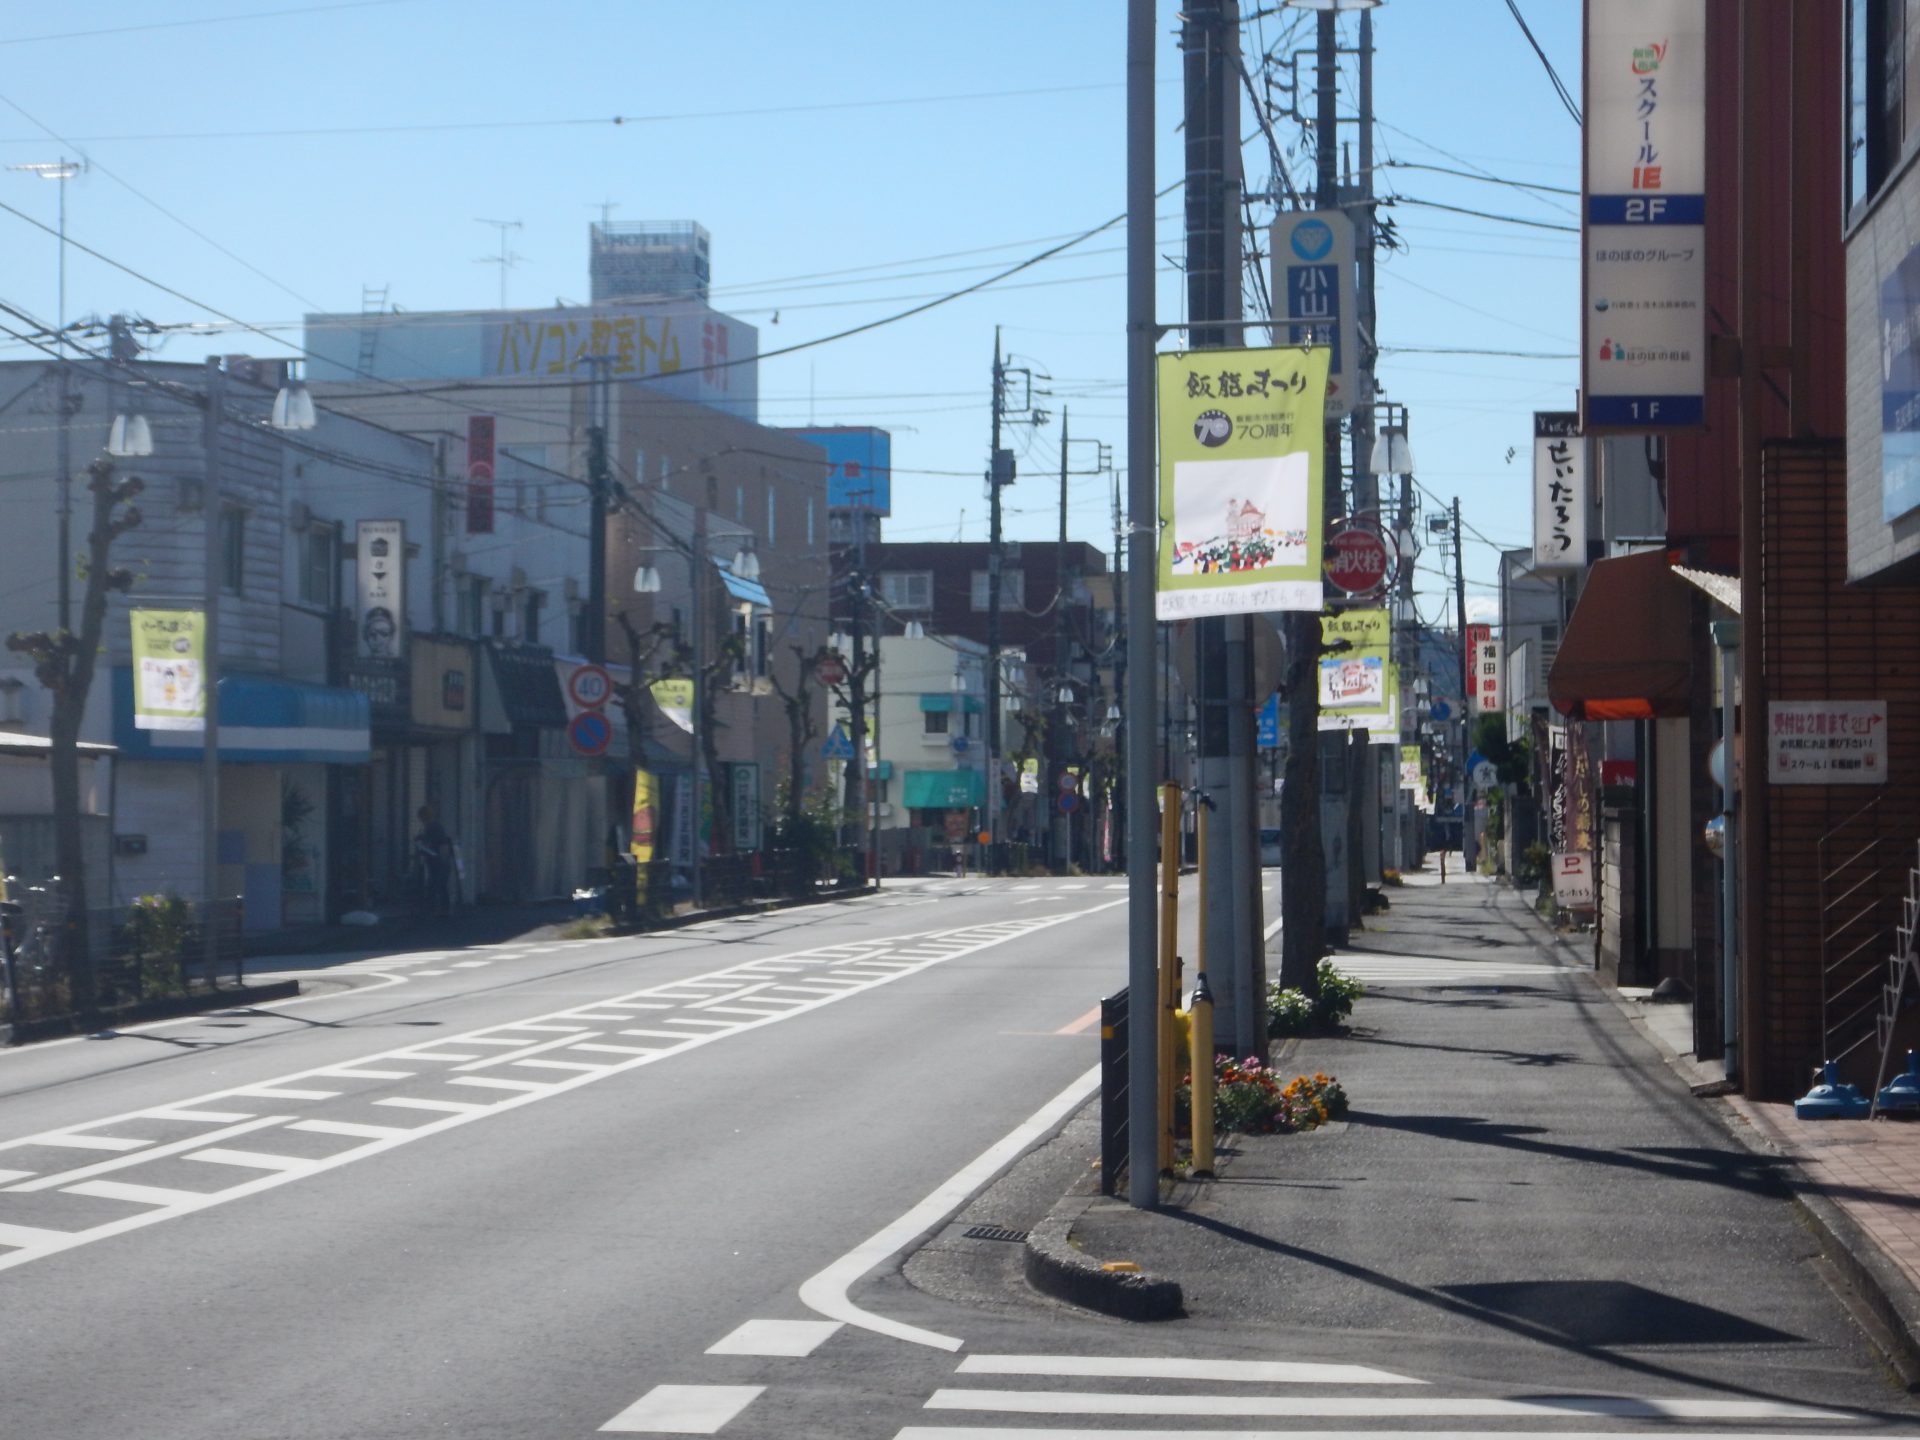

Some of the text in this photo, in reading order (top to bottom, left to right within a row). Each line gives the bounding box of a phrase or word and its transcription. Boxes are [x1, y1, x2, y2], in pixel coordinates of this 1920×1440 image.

[1632, 78, 1662, 189] スクール IE
[1625, 199, 1667, 221] 2F
[1596, 250, 1694, 262] ほのぼのグループ
[497, 314, 681, 374] パソコン教室トム
[1187, 369, 1307, 398] 飯能まつり
[1236, 423, 1293, 440] 70周年
[1548, 440, 1574, 551] せいたろう
[1333, 549, 1382, 574] 消火栓
[579, 678, 602, 697] 40
[1483, 645, 1496, 709] 福田歯科
